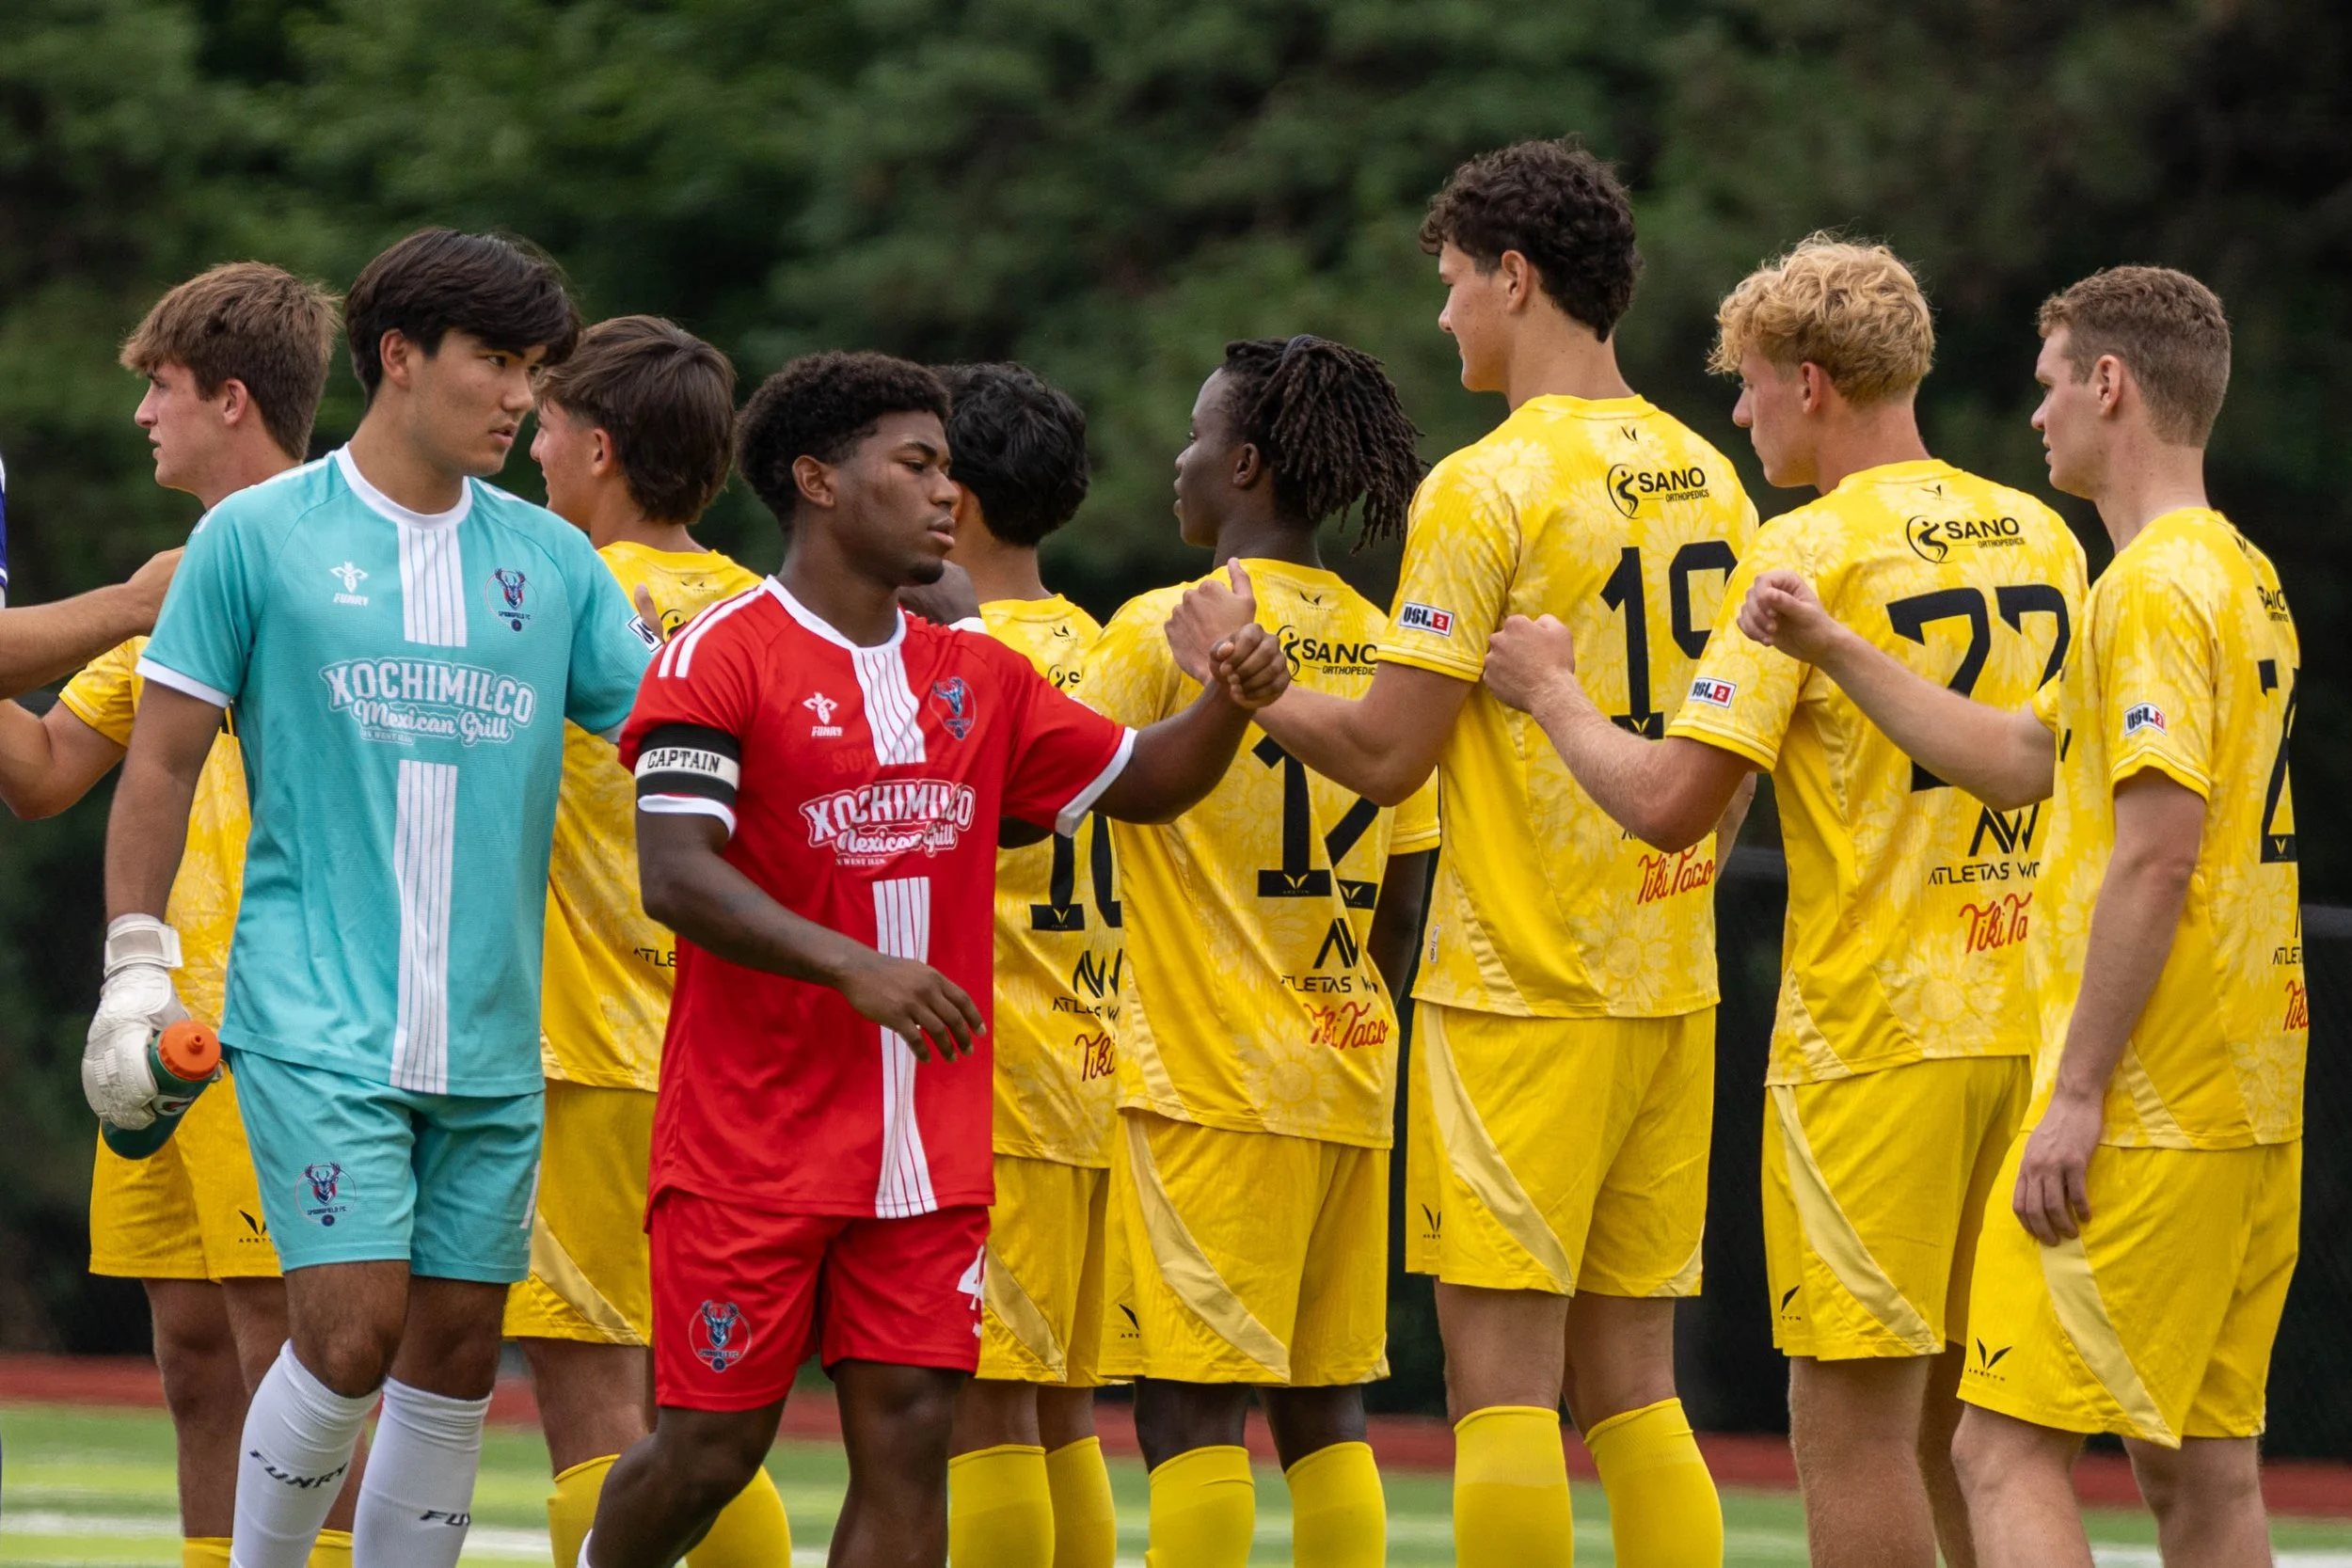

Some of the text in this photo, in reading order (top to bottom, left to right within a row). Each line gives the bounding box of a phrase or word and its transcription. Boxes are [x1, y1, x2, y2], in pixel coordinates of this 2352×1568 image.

[1638, 467, 1706, 493] SANO
[1666, 489, 1709, 502] ORTHOPEDICS
[1945, 517, 2020, 539] SANO
[1978, 537, 2026, 548] ORTHOPEDICS
[1322, 665, 1377, 676] ORTHOPEDIC
[326, 662, 533, 723] XOCHIMILCO
[353, 700, 510, 742] Mexican Grill
[647, 750, 721, 773] CAPTAIN
[1929, 863, 2010, 885] ATLETAS
[1959, 892, 2033, 954] Tiki Ta
[633, 947, 676, 968] ATLE
[1340, 1001, 1390, 1051] Taco
[1074, 1031, 1117, 1082] Tiki
